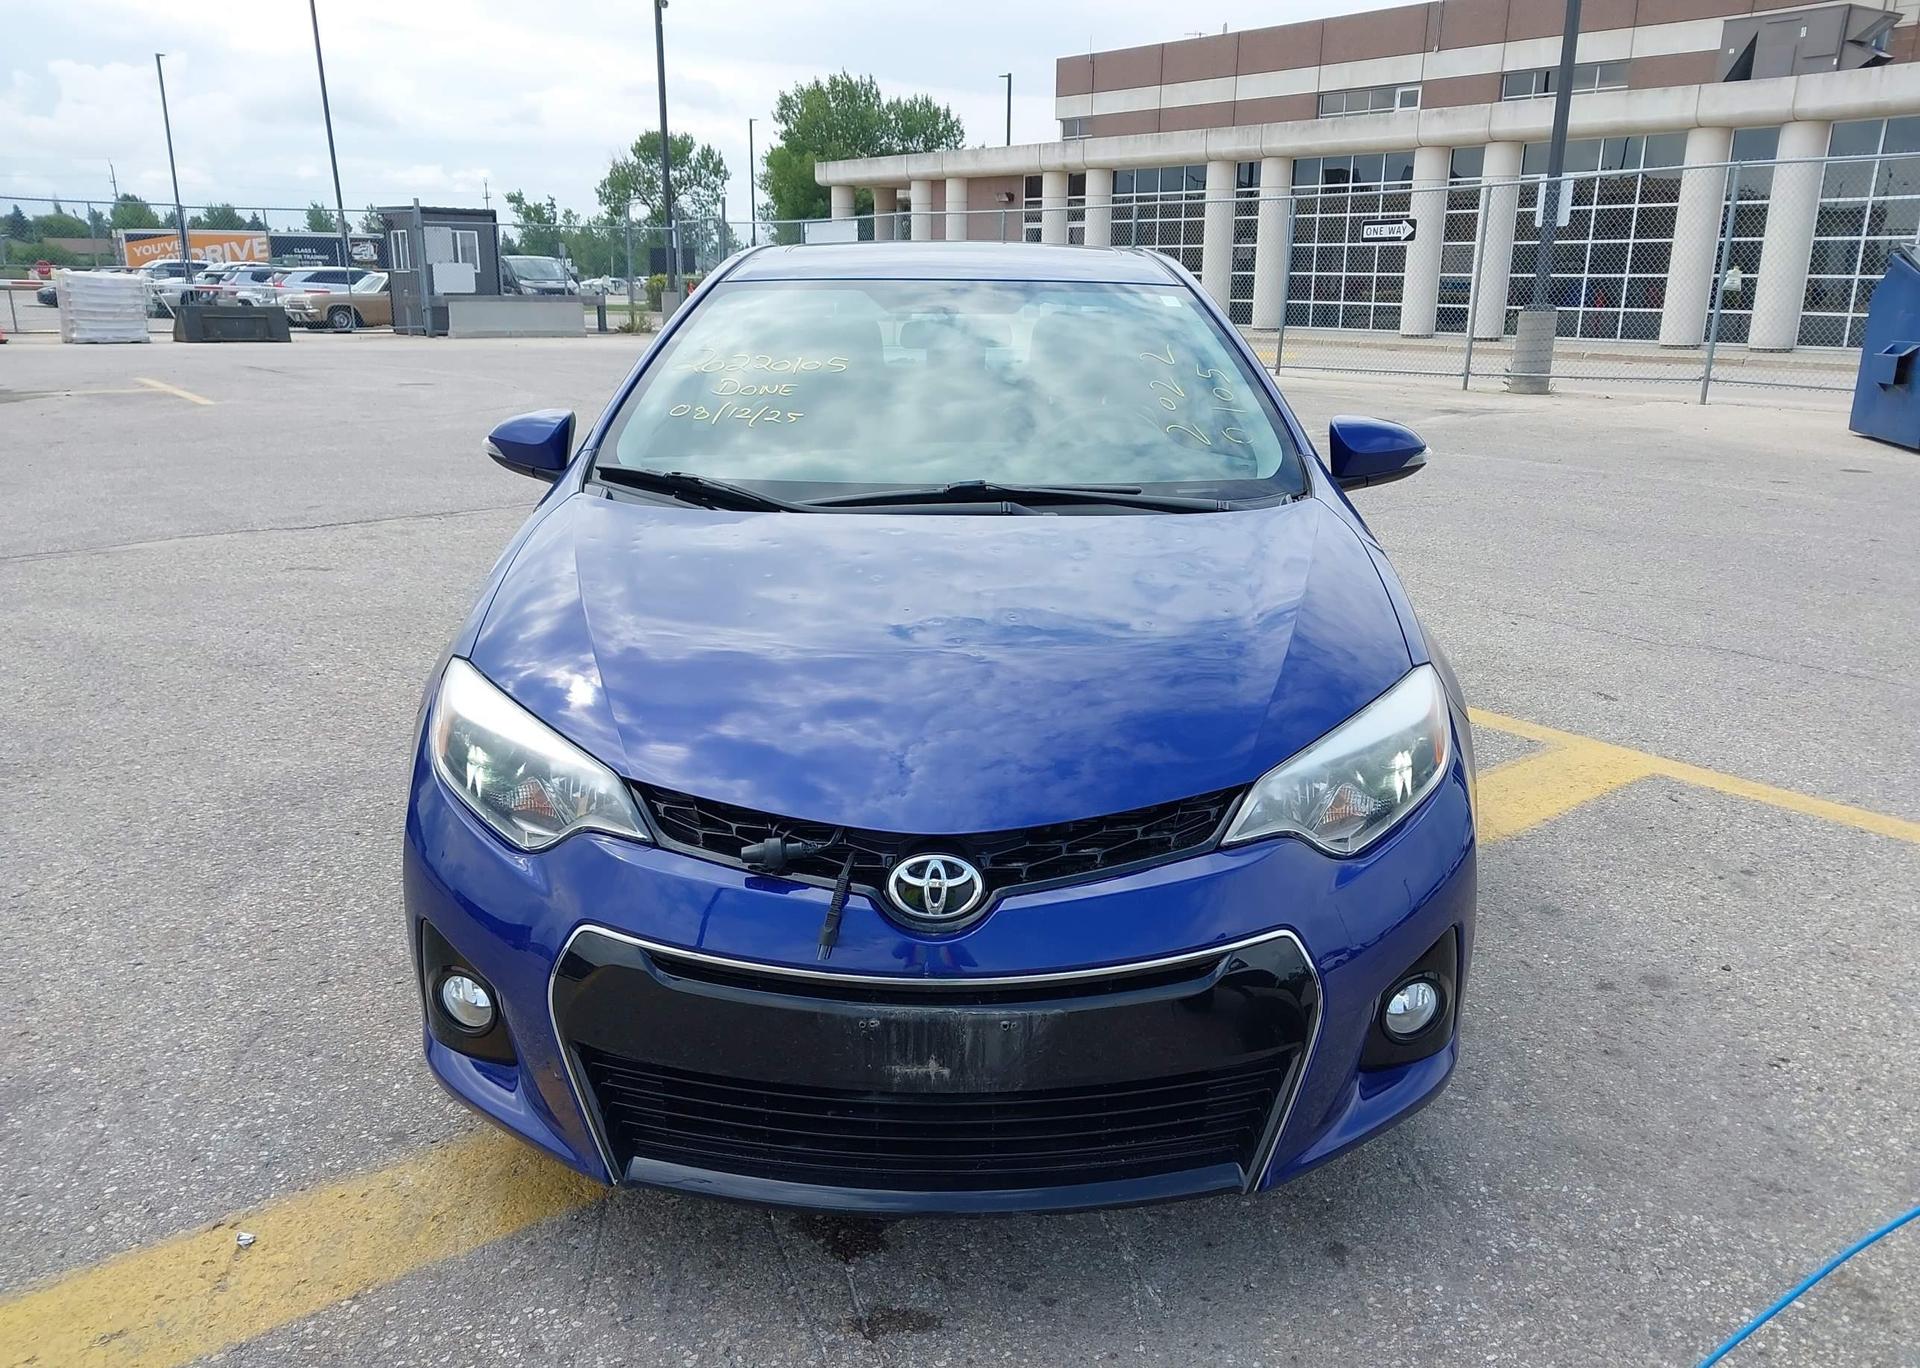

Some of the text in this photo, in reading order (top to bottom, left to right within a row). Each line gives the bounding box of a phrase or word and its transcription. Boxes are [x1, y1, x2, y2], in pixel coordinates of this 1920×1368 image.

[1365, 225, 1407, 236] ONE WAY
[132, 239, 181, 256] YOU'VE
[673, 348, 849, 374] 20220105
[712, 378, 799, 396] DONE
